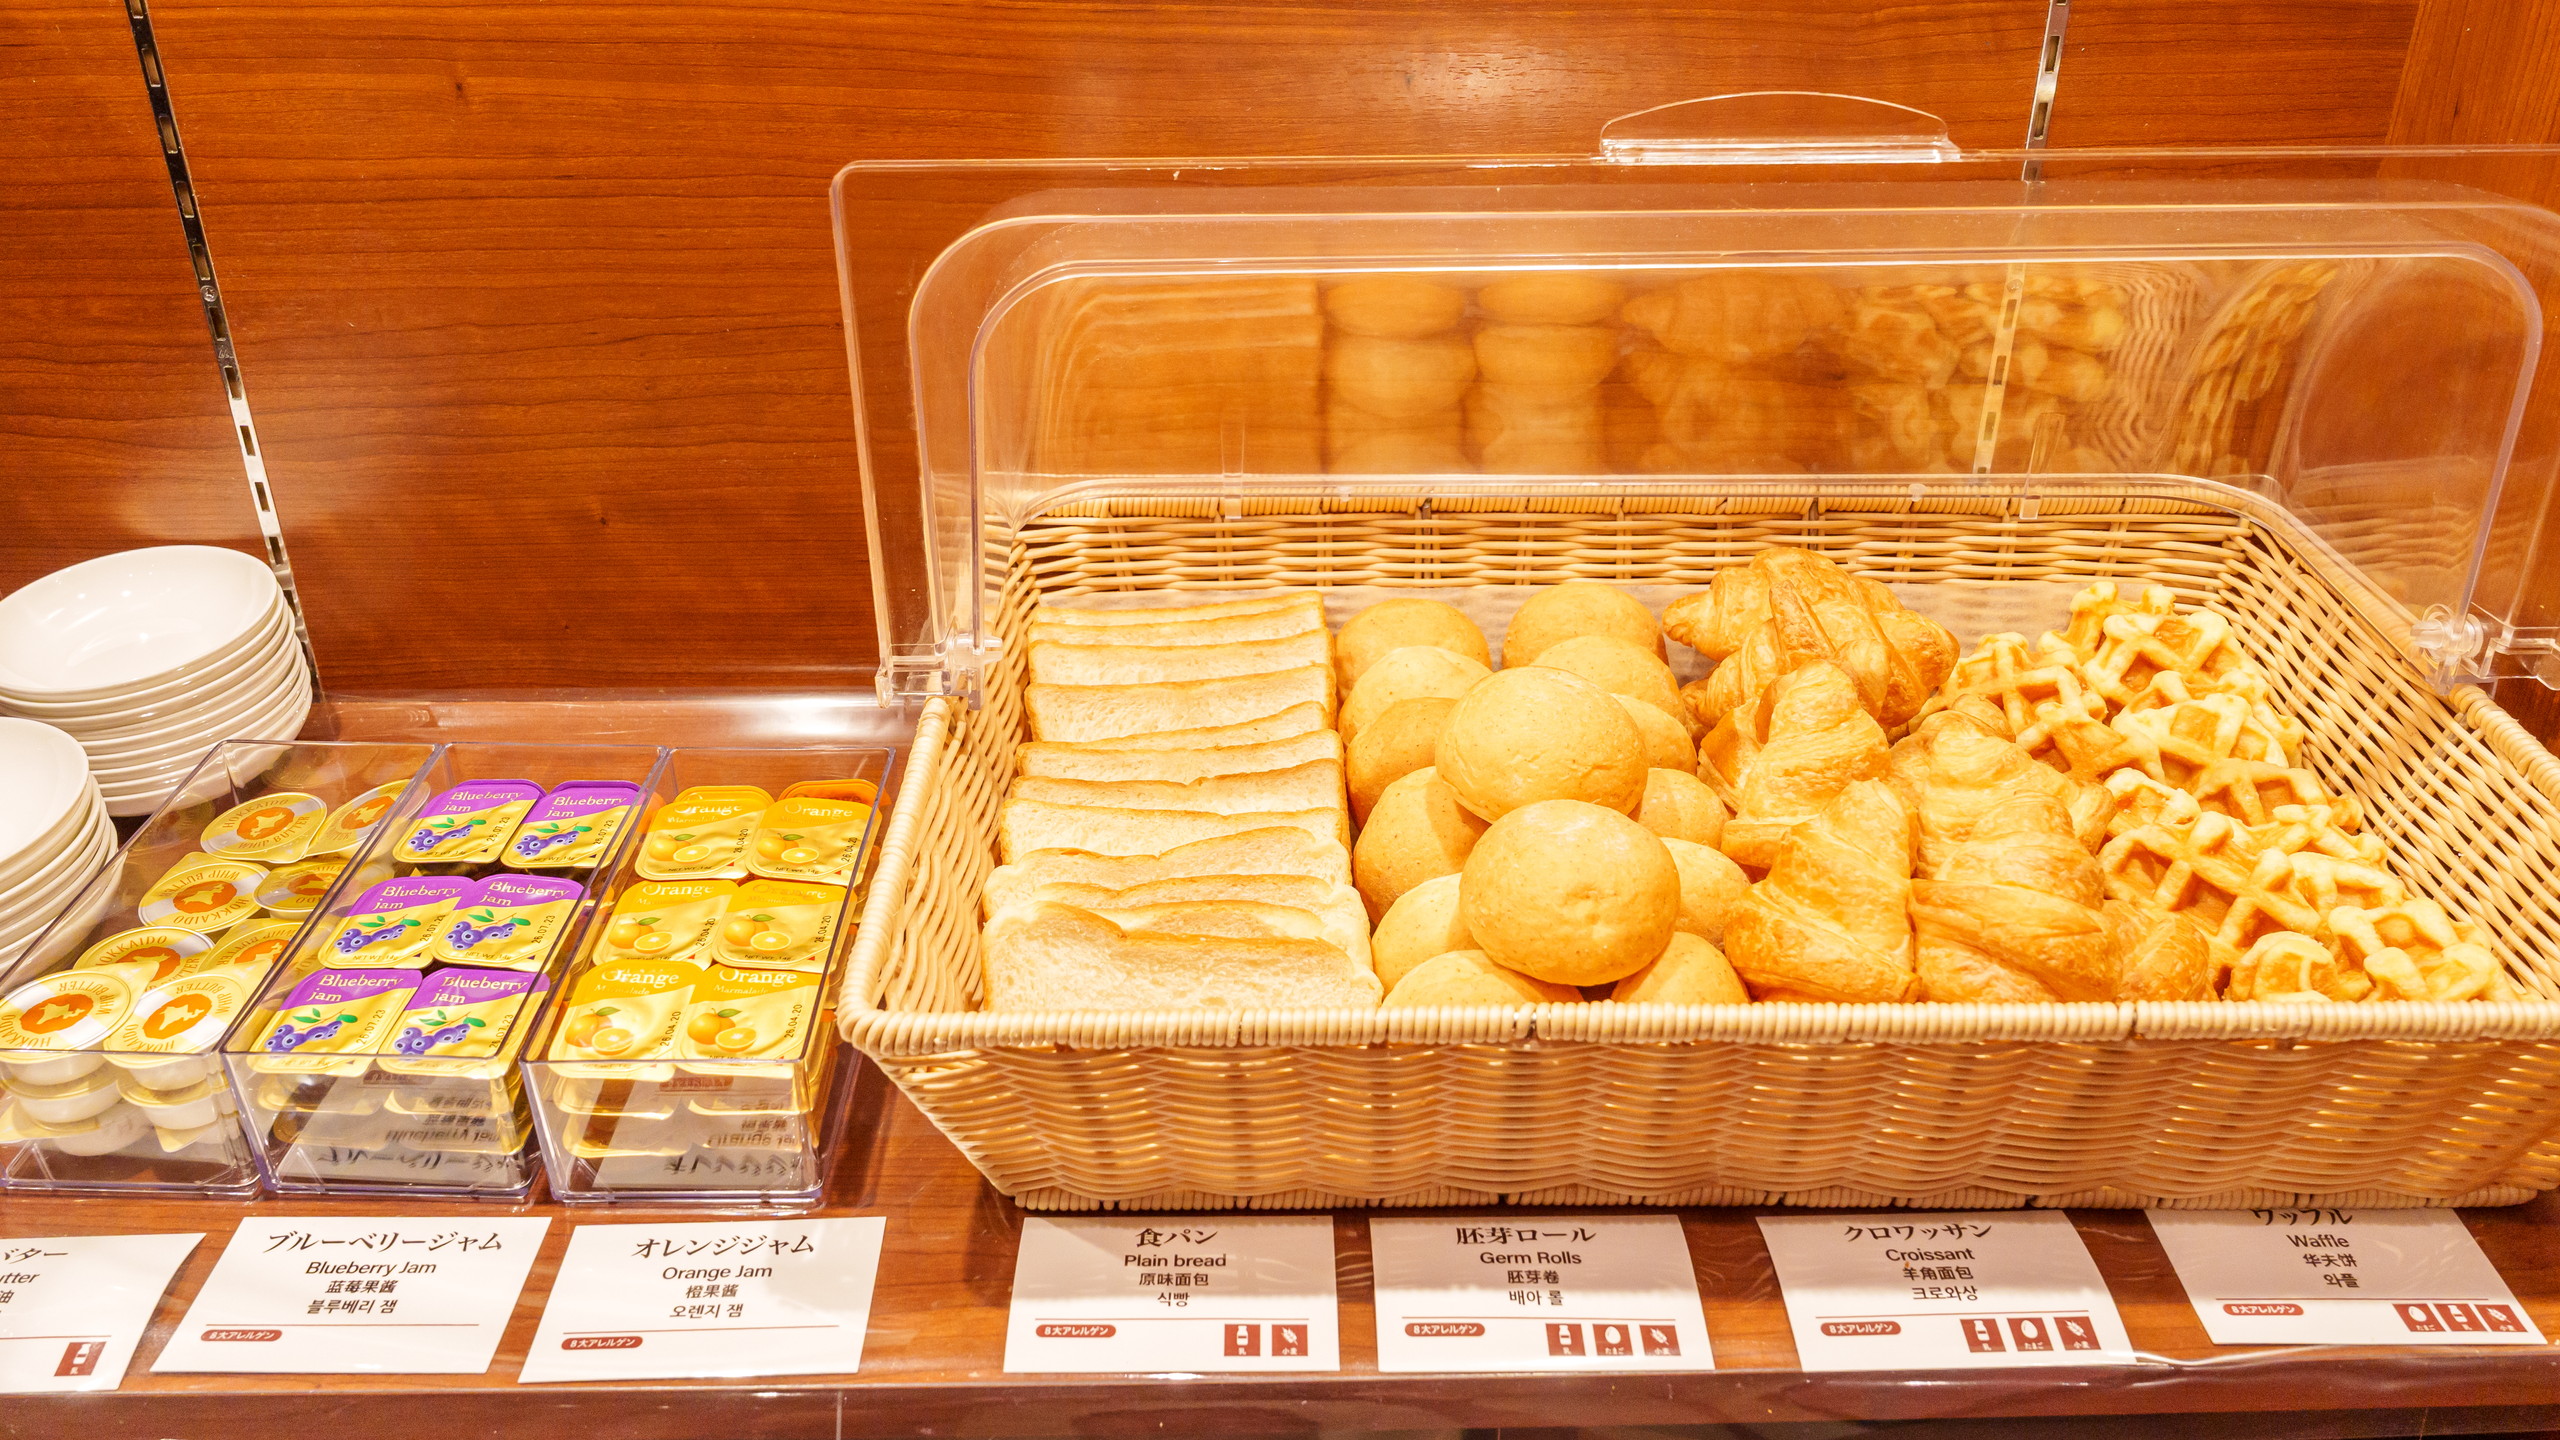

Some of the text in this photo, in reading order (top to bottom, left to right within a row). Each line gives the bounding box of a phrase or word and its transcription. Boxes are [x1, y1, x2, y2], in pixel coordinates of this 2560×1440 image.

[451, 790, 524, 803] Blueberry
[553, 795, 627, 806] Blueberry
[222, 799, 289, 829] HOKKAIDO
[441, 801, 472, 812] jam
[544, 806, 575, 818] jam
[785, 802, 853, 820] Orange
[238, 840, 270, 849] WHIP
[273, 816, 310, 843] BUTTER
[159, 869, 241, 897] WHIP BUTTER
[488, 881, 571, 899] Blueberry
[642, 883, 715, 898] Orange
[381, 885, 463, 898] Blueberry
[479, 891, 512, 906] jam
[172, 898, 250, 925] HOKKAIDO
[371, 898, 404, 912] jam
[318, 974, 404, 990] Blueberry
[442, 975, 528, 994] Blueberry
[601, 968, 680, 989] Orange
[718, 969, 798, 988] Orange
[59, 980, 110, 996] BUTTER
[176, 982, 226, 995] BUTTER
[308, 987, 343, 1002] jam
[713, 984, 769, 995] Marmalade
[214, 992, 233, 1014] WHIP
[430, 989, 466, 1004] jam
[783, 1003, 803, 1039] 26.04.20
[2249, 1207, 2354, 1226] ワッフル
[1135, 1227, 1219, 1249] 食パン
[1455, 1226, 1598, 1246] 胚芽ロール
[1843, 1223, 1993, 1242] クロワッサン
[2285, 1233, 2351, 1248] Waffle
[262, 1229, 504, 1254] ブルーベリージャム
[630, 1233, 816, 1260] オレンジジャム
[1123, 1253, 1228, 1268] Plain bread
[1479, 1251, 1583, 1265] Germ Rolls
[1885, 1248, 1976, 1262] Croissant
[2302, 1252, 2359, 1268] 华夫饼
[304, 1261, 437, 1277] Blueberry Jam
[661, 1264, 774, 1282] Orange Jam
[1506, 1269, 1561, 1285] 胚芽卷
[1901, 1266, 1975, 1282] 羊角面包
[324, 1279, 400, 1295] 蓝莓果酱
[1138, 1272, 1210, 1288] 原味面包
[2322, 1272, 2361, 1289] 와플
[684, 1283, 739, 1300] 橙果酱
[1156, 1291, 1191, 1308] 식빵
[1508, 1289, 1565, 1306] 배아 롤
[1911, 1286, 1979, 1302] 크로와상
[306, 1298, 399, 1315] 블루베리 잼
[668, 1302, 744, 1320] 오렌지 잼
[2231, 1305, 2296, 1315] 8大アレルゲン
[208, 1330, 276, 1341] 8大アレルゲン
[1043, 1325, 1110, 1337] 8大アレルゲン
[1413, 1324, 1478, 1335] 8大アレルゲン
[1828, 1323, 1894, 1335] 8大アレルゲン
[569, 1337, 636, 1349] 8大アレルゲン
[1281, 1347, 1298, 1355] 小麦
